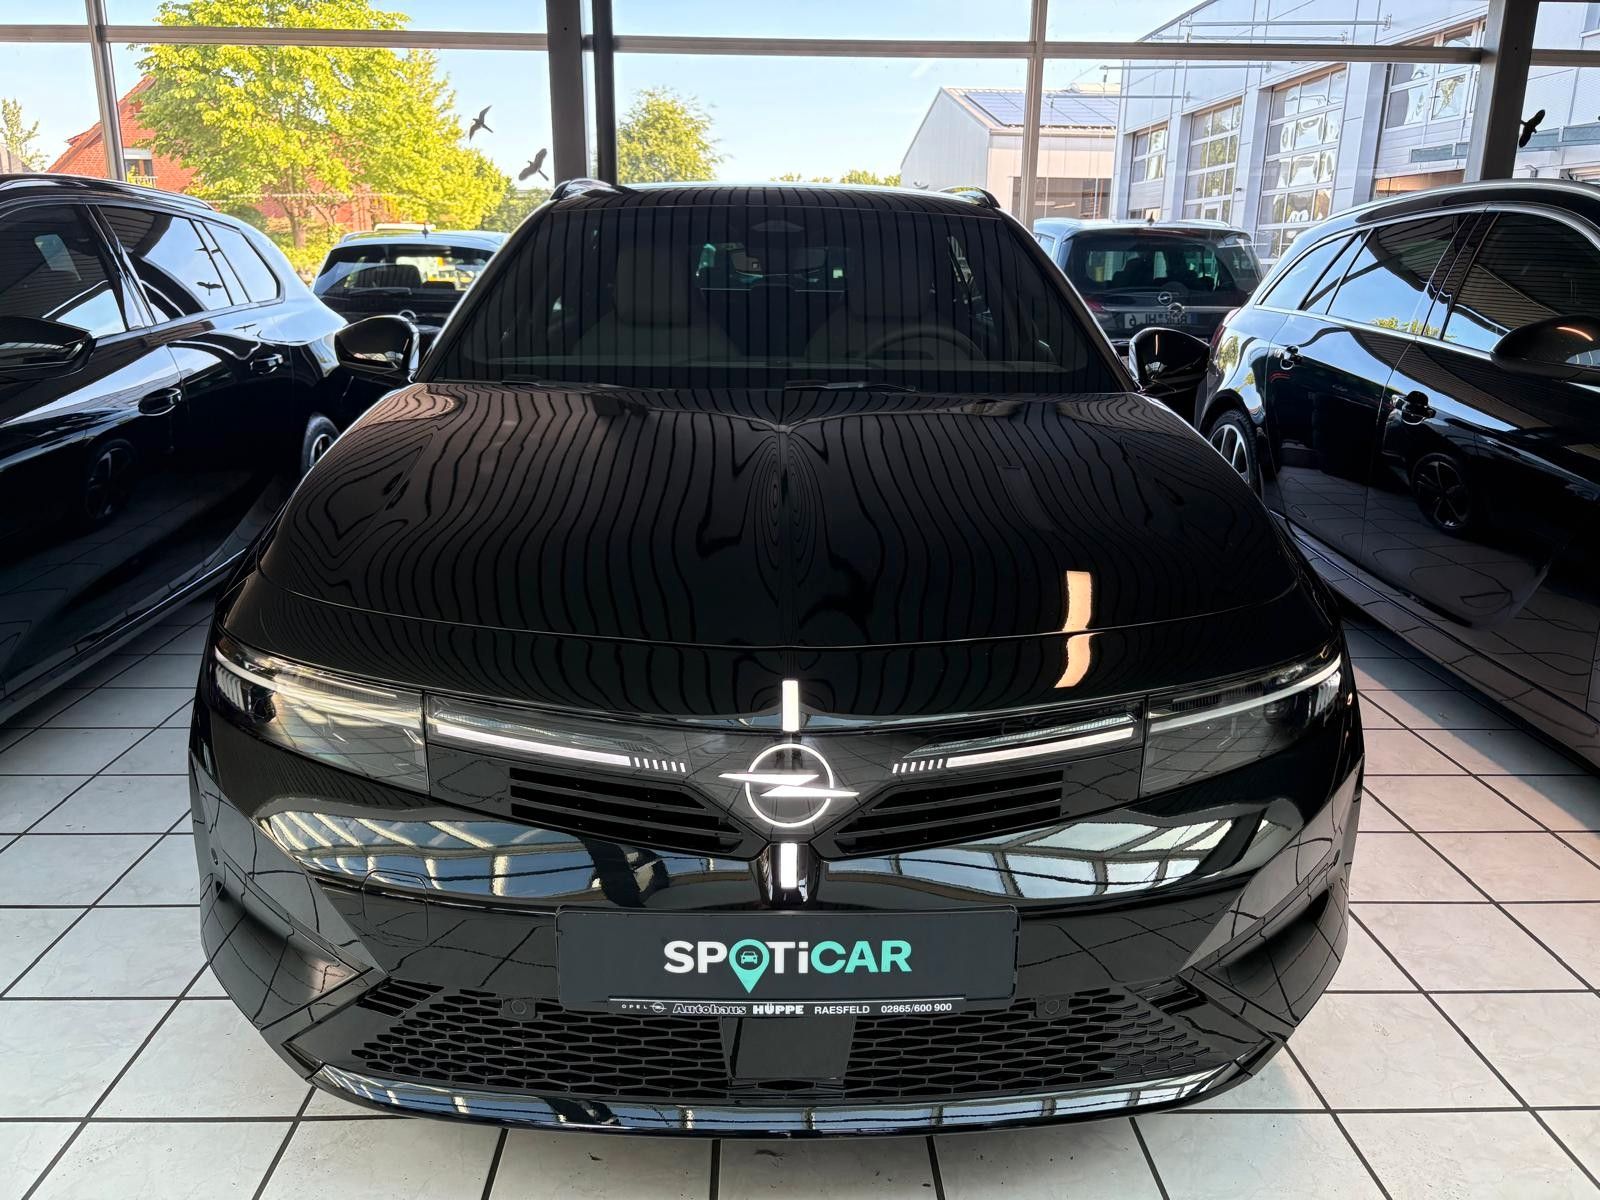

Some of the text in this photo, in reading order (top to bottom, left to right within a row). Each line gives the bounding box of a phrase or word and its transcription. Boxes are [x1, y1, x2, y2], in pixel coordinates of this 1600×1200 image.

[672, 1003, 747, 1015] Autohaus
[752, 1003, 805, 1015] HÜPPE
[814, 1005, 870, 1014] RAESFELD
[880, 1003, 933, 1013] 02865/600
[933, 1002, 952, 1012] 900
